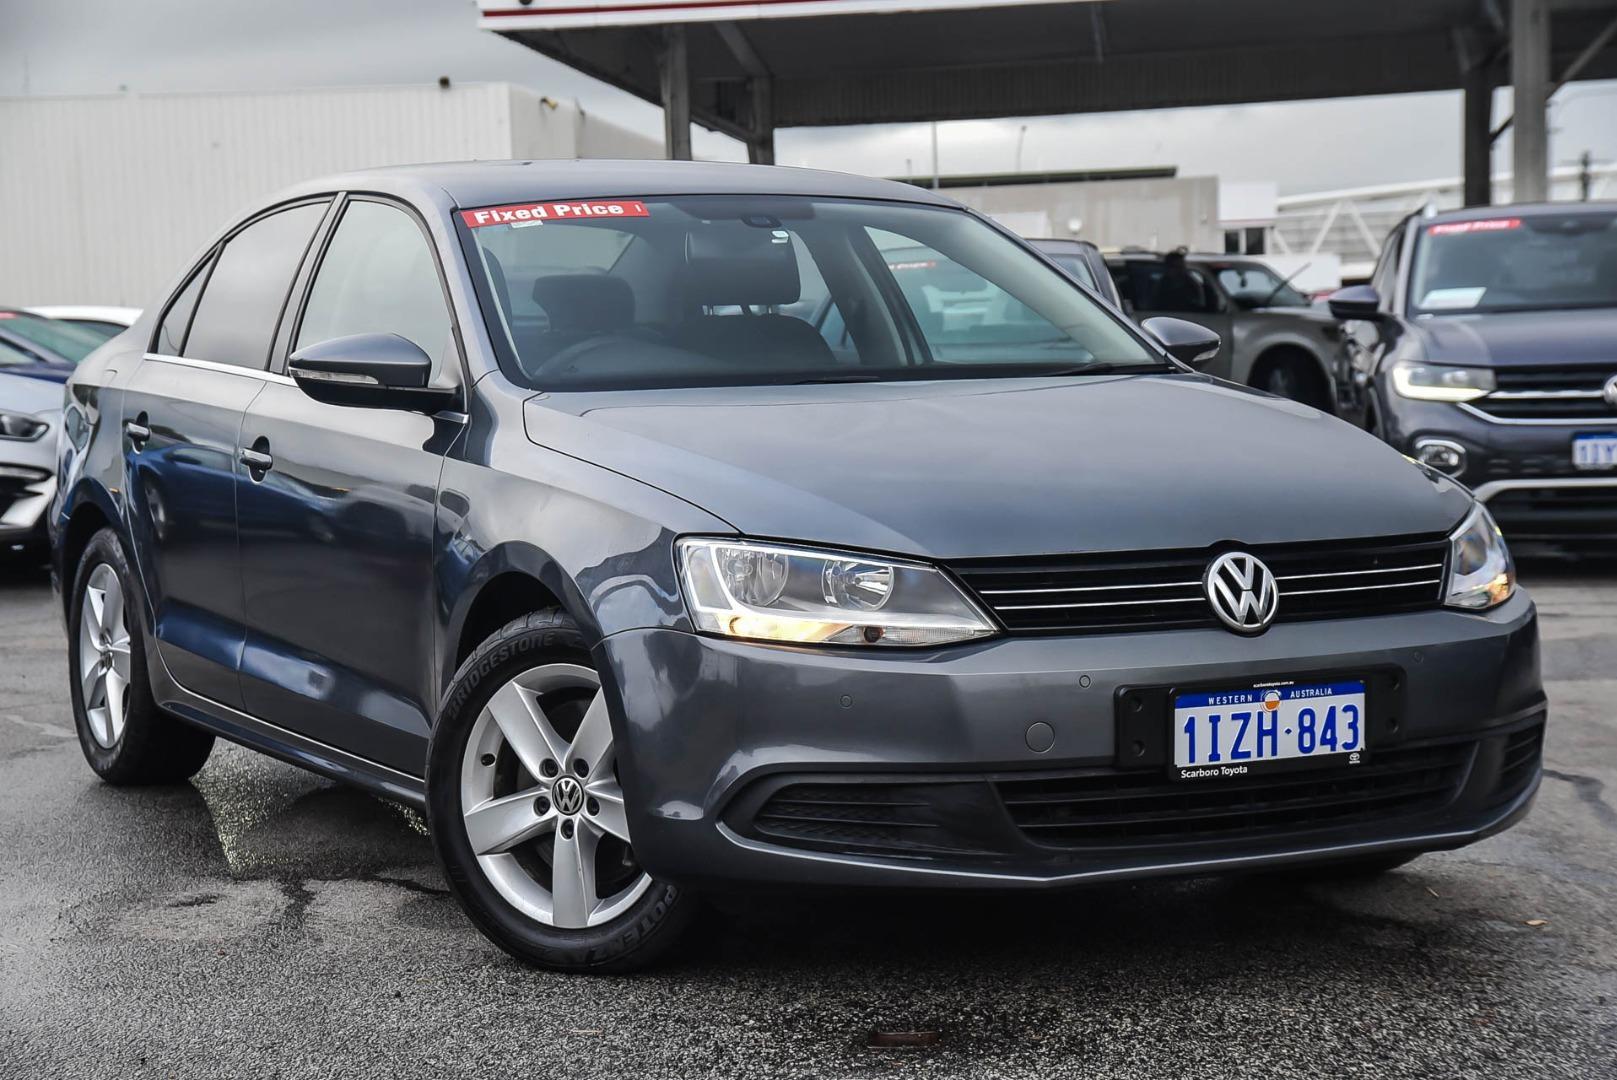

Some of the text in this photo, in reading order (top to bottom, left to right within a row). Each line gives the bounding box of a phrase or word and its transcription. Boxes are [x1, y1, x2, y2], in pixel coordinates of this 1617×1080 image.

[473, 206, 548, 224] Fixed
[552, 203, 625, 217] Price
[1208, 552, 1279, 631] VW
[448, 632, 556, 720] BRIDGESTONE
[1208, 687, 1333, 706] WESTERN AUSTRALIA
[1180, 766, 1248, 779] Scarboro Toyota
[553, 776, 583, 815] VW
[583, 884, 678, 962] POTENZ
